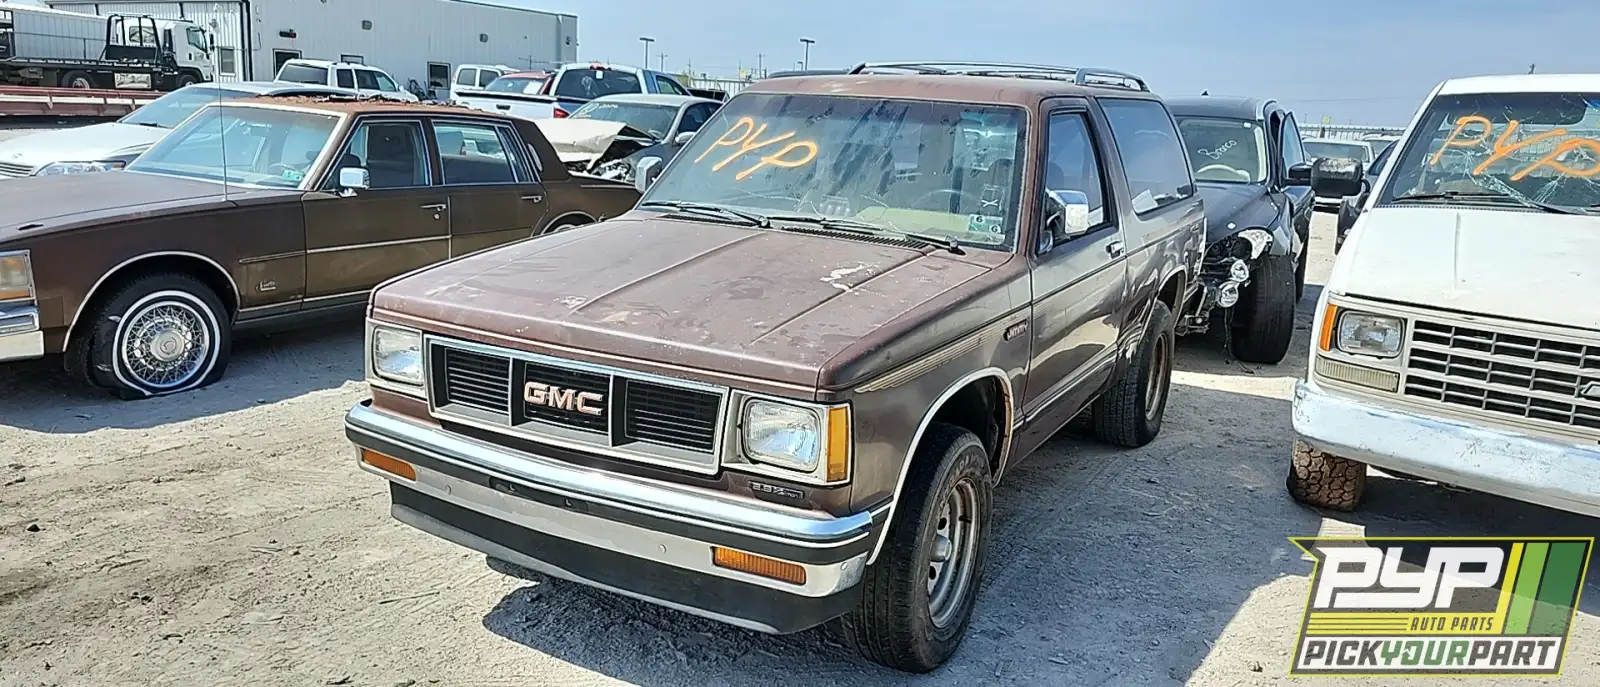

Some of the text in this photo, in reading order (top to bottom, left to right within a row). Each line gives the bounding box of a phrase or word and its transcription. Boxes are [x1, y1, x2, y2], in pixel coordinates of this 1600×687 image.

[694, 116, 818, 180] PYP
[1430, 115, 1600, 182] PYP
[524, 381, 604, 416] GMC
